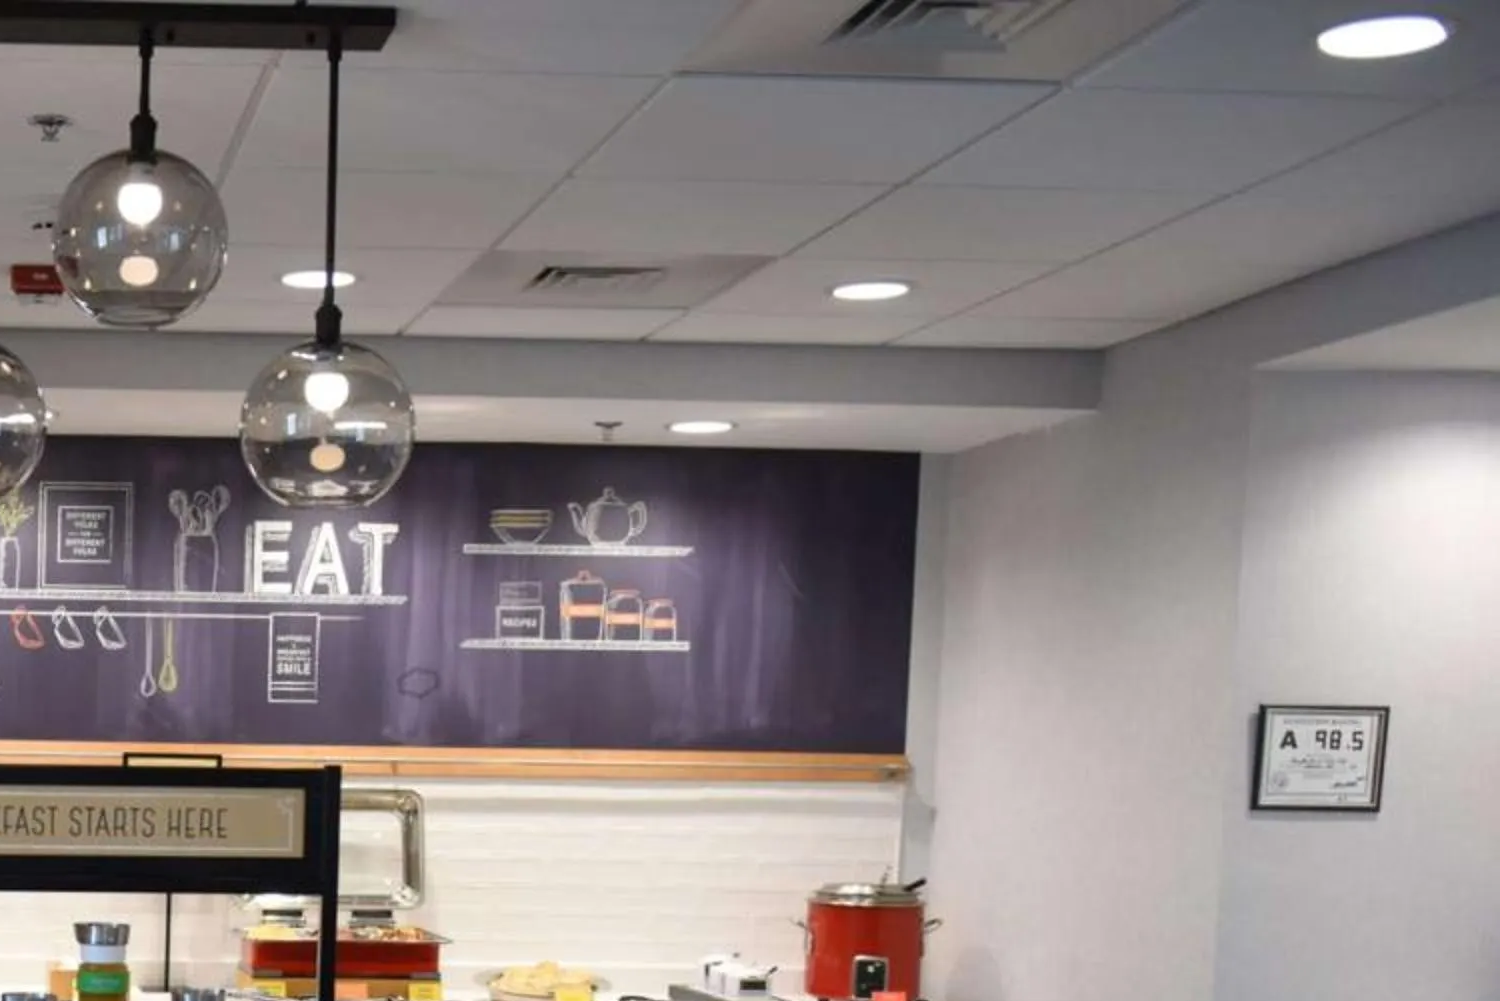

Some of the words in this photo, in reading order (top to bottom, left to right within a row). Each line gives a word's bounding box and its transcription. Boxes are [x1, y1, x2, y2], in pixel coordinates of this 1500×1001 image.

[245, 520, 399, 596] EAT
[276, 662, 312, 676] SMILE
[1279, 729, 1298, 749] A
[1315, 729, 1364, 752] 98.5
[68, 806, 157, 838] STARTS
[166, 807, 228, 839] HERE
